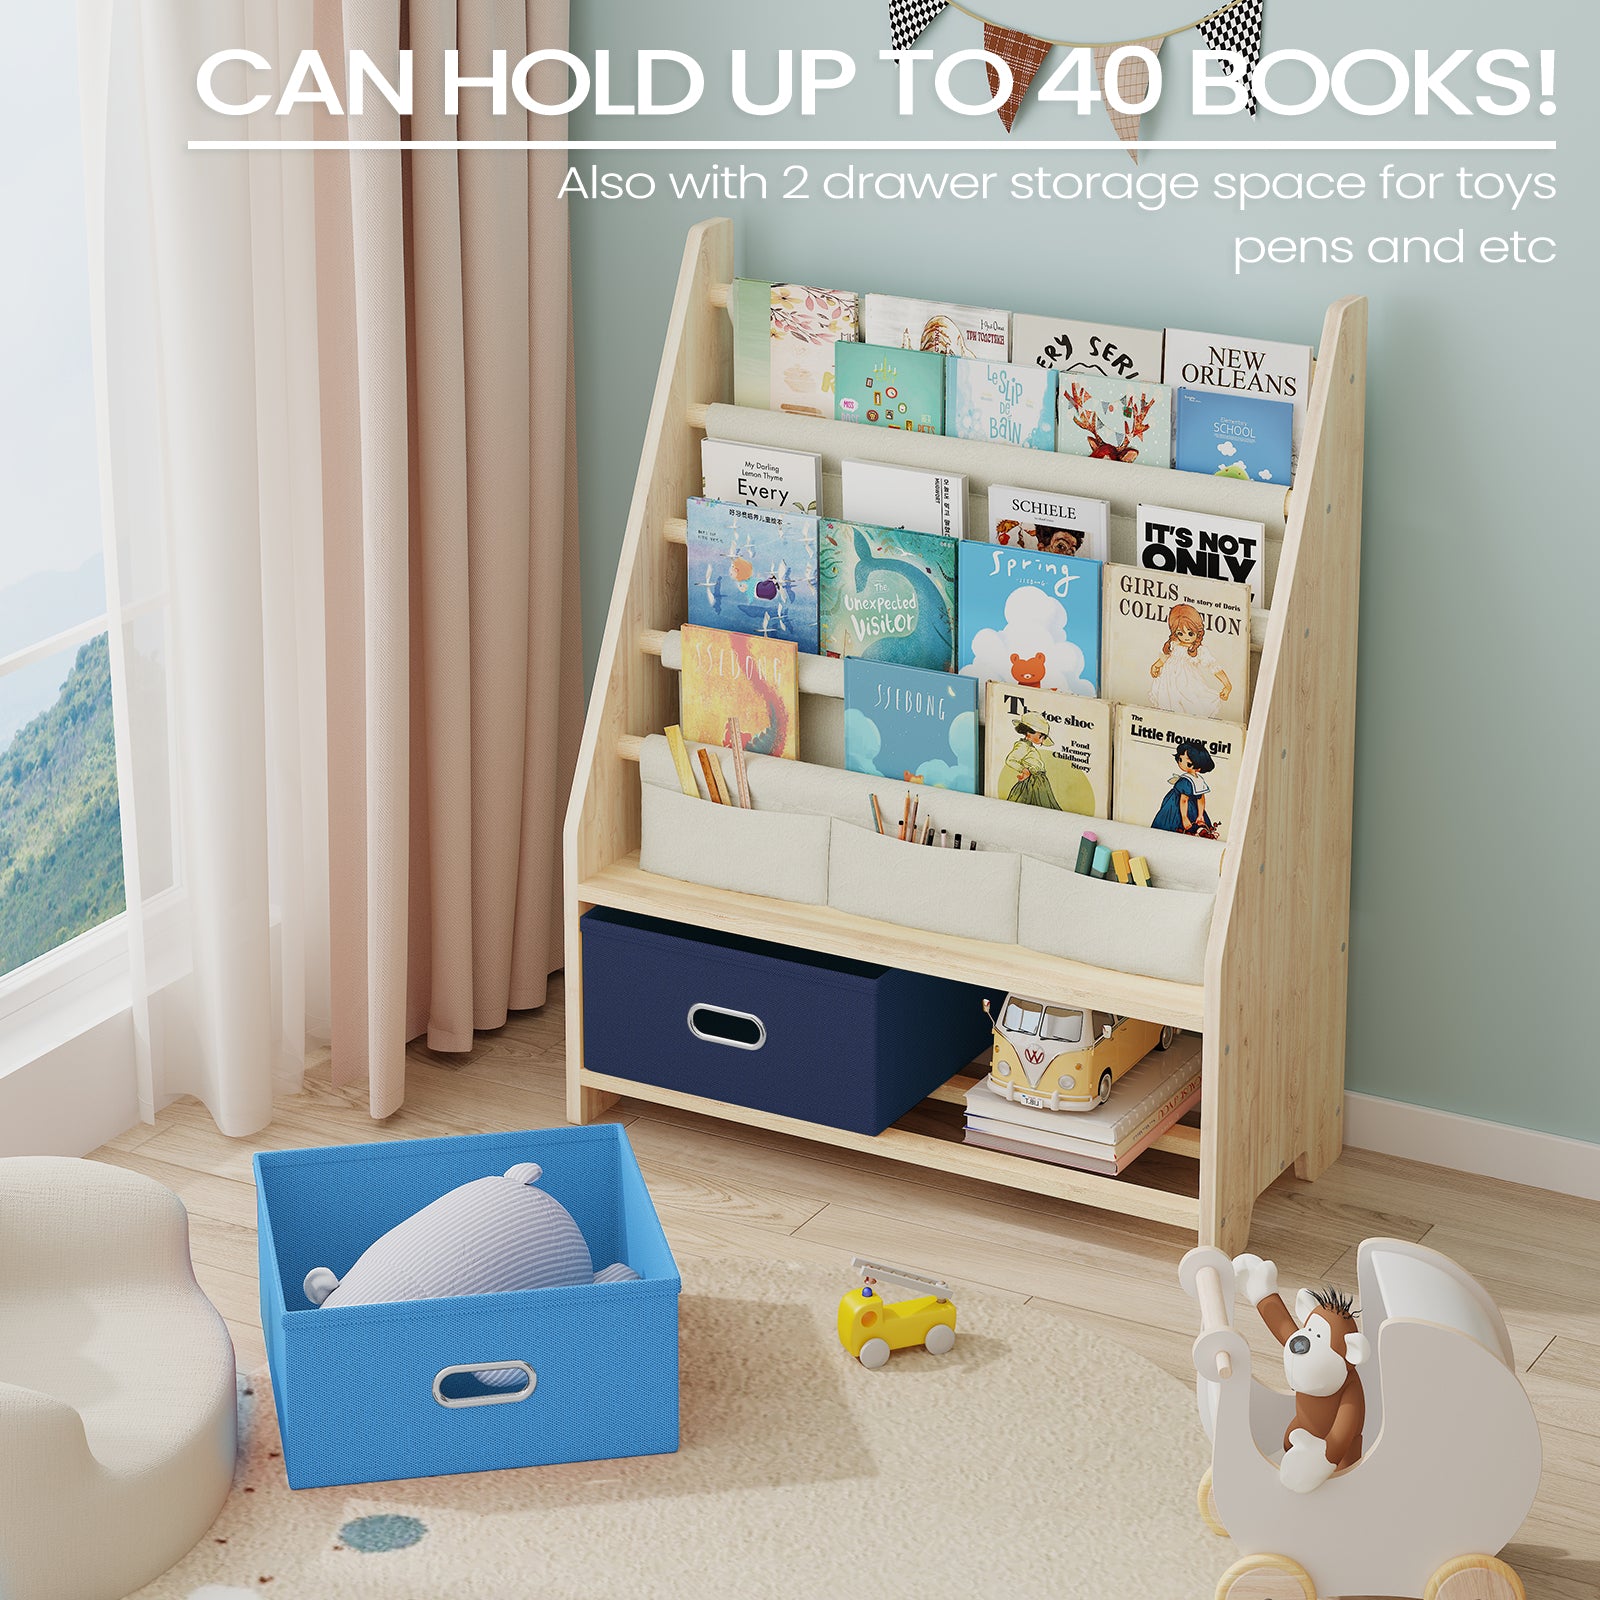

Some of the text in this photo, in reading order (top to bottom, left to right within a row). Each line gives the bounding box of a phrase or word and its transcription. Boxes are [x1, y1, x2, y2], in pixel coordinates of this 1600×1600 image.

[1208, 345, 1266, 371] NEW
[1181, 363, 1297, 398] ORLEANS
[1213, 422, 1257, 439] SCHOOL
[741, 469, 784, 482] Lemon Thyme
[744, 461, 780, 474] My Darling
[737, 477, 789, 507] Every
[1011, 498, 1077, 520] SCHIELE
[1145, 521, 1257, 559] IT'S NOT
[988, 550, 1081, 598] Spring
[1141, 543, 1257, 585] ONLY
[873, 583, 888, 592] The
[1120, 574, 1179, 601] GIRLS
[843, 593, 918, 613] Unexpected
[1183, 596, 1195, 605] The
[1196, 599, 1213, 610] story
[1223, 603, 1241, 612] Doris
[850, 613, 915, 642] Visitor
[1119, 598, 1242, 636] COLLION
[695, 642, 782, 689] SSEBONG
[874, 683, 946, 721] SSEBONG
[1131, 714, 1143, 722] The
[1061, 745, 1092, 758] Memory
[1070, 739, 1090, 750] Fond
[1130, 724, 1164, 741] Little
[1209, 740, 1232, 755] girl
[1052, 751, 1090, 765] Childhood
[1071, 762, 1092, 773] Story
